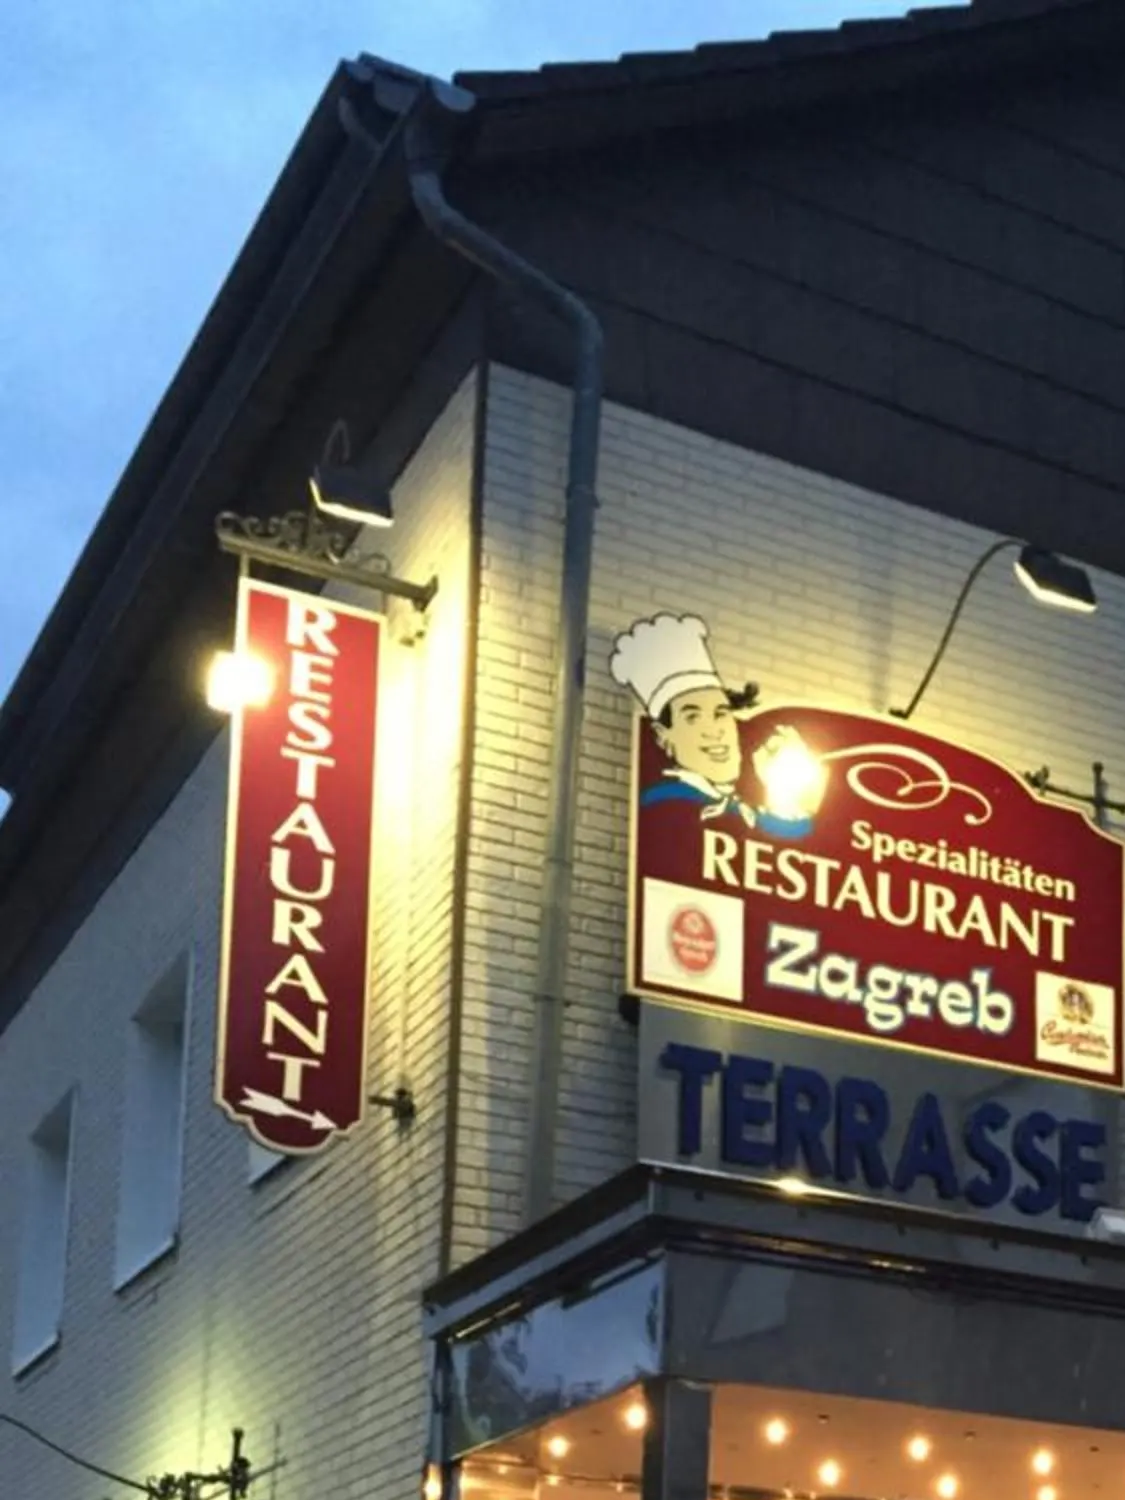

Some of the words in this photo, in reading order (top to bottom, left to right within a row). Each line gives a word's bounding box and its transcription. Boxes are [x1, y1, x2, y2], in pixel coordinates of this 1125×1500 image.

[262, 600, 338, 1100] RESTAURANT
[701, 829, 1076, 962] RESTAURANT
[851, 819, 1077, 902] Spezialitäten
[765, 922, 1015, 1033] Zagreb
[662, 1043, 1107, 1221] TERRASSE
